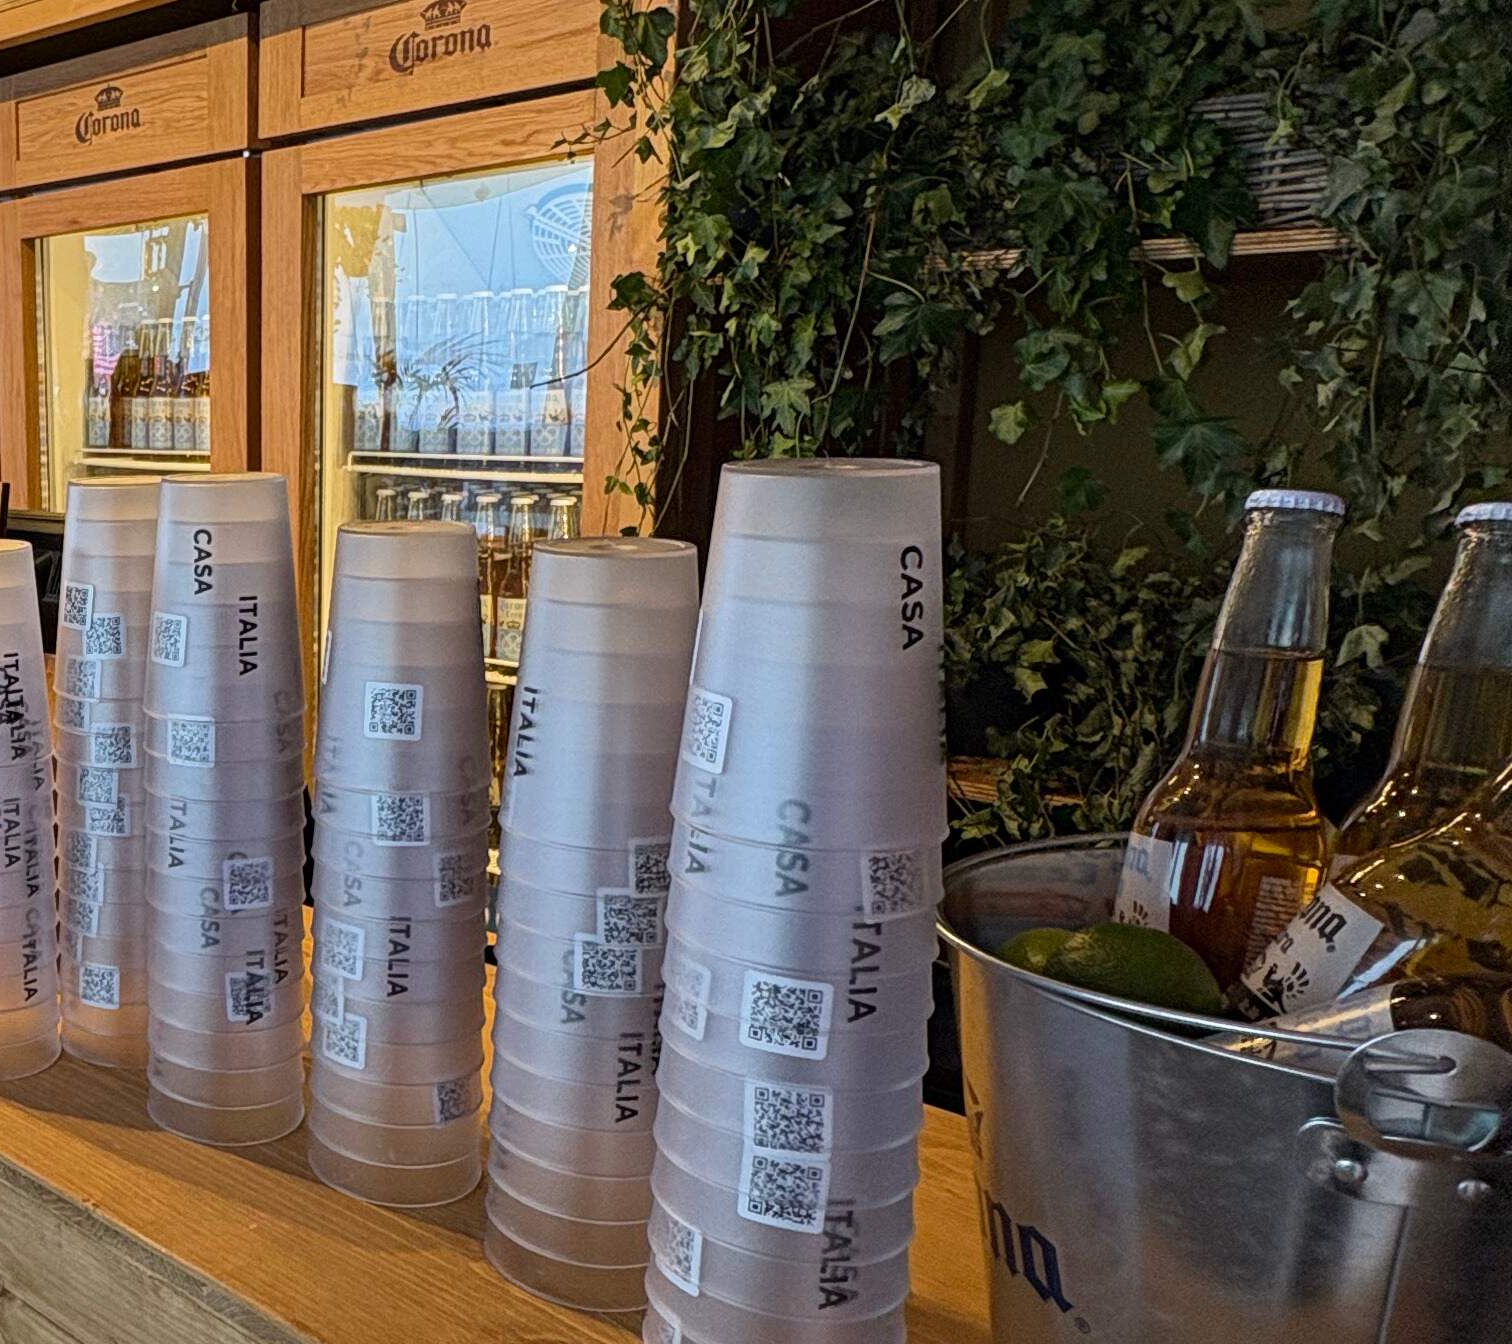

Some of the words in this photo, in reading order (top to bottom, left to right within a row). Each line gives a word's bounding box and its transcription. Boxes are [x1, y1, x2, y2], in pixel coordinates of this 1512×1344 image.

[389, 23, 492, 75] Corona
[74, 106, 141, 145] Corona
[193, 528, 213, 595] CASA
[238, 595, 258, 676] ITALIA
[900, 545, 924, 651] CASA
[514, 686, 539, 777] ITALIA
[3, 797, 21, 868] ITALIA
[168, 794, 187, 868] ITALIA
[775, 798, 811, 896] CASA
[343, 840, 364, 907] CASA
[200, 887, 220, 949] CASA
[387, 915, 412, 997] ITALIA
[245, 949, 265, 1025] ITALIA
[847, 905, 883, 1023] TALIA
[615, 1032, 644, 1123] ITALIA
[818, 1199, 855, 1310] ITALIA
